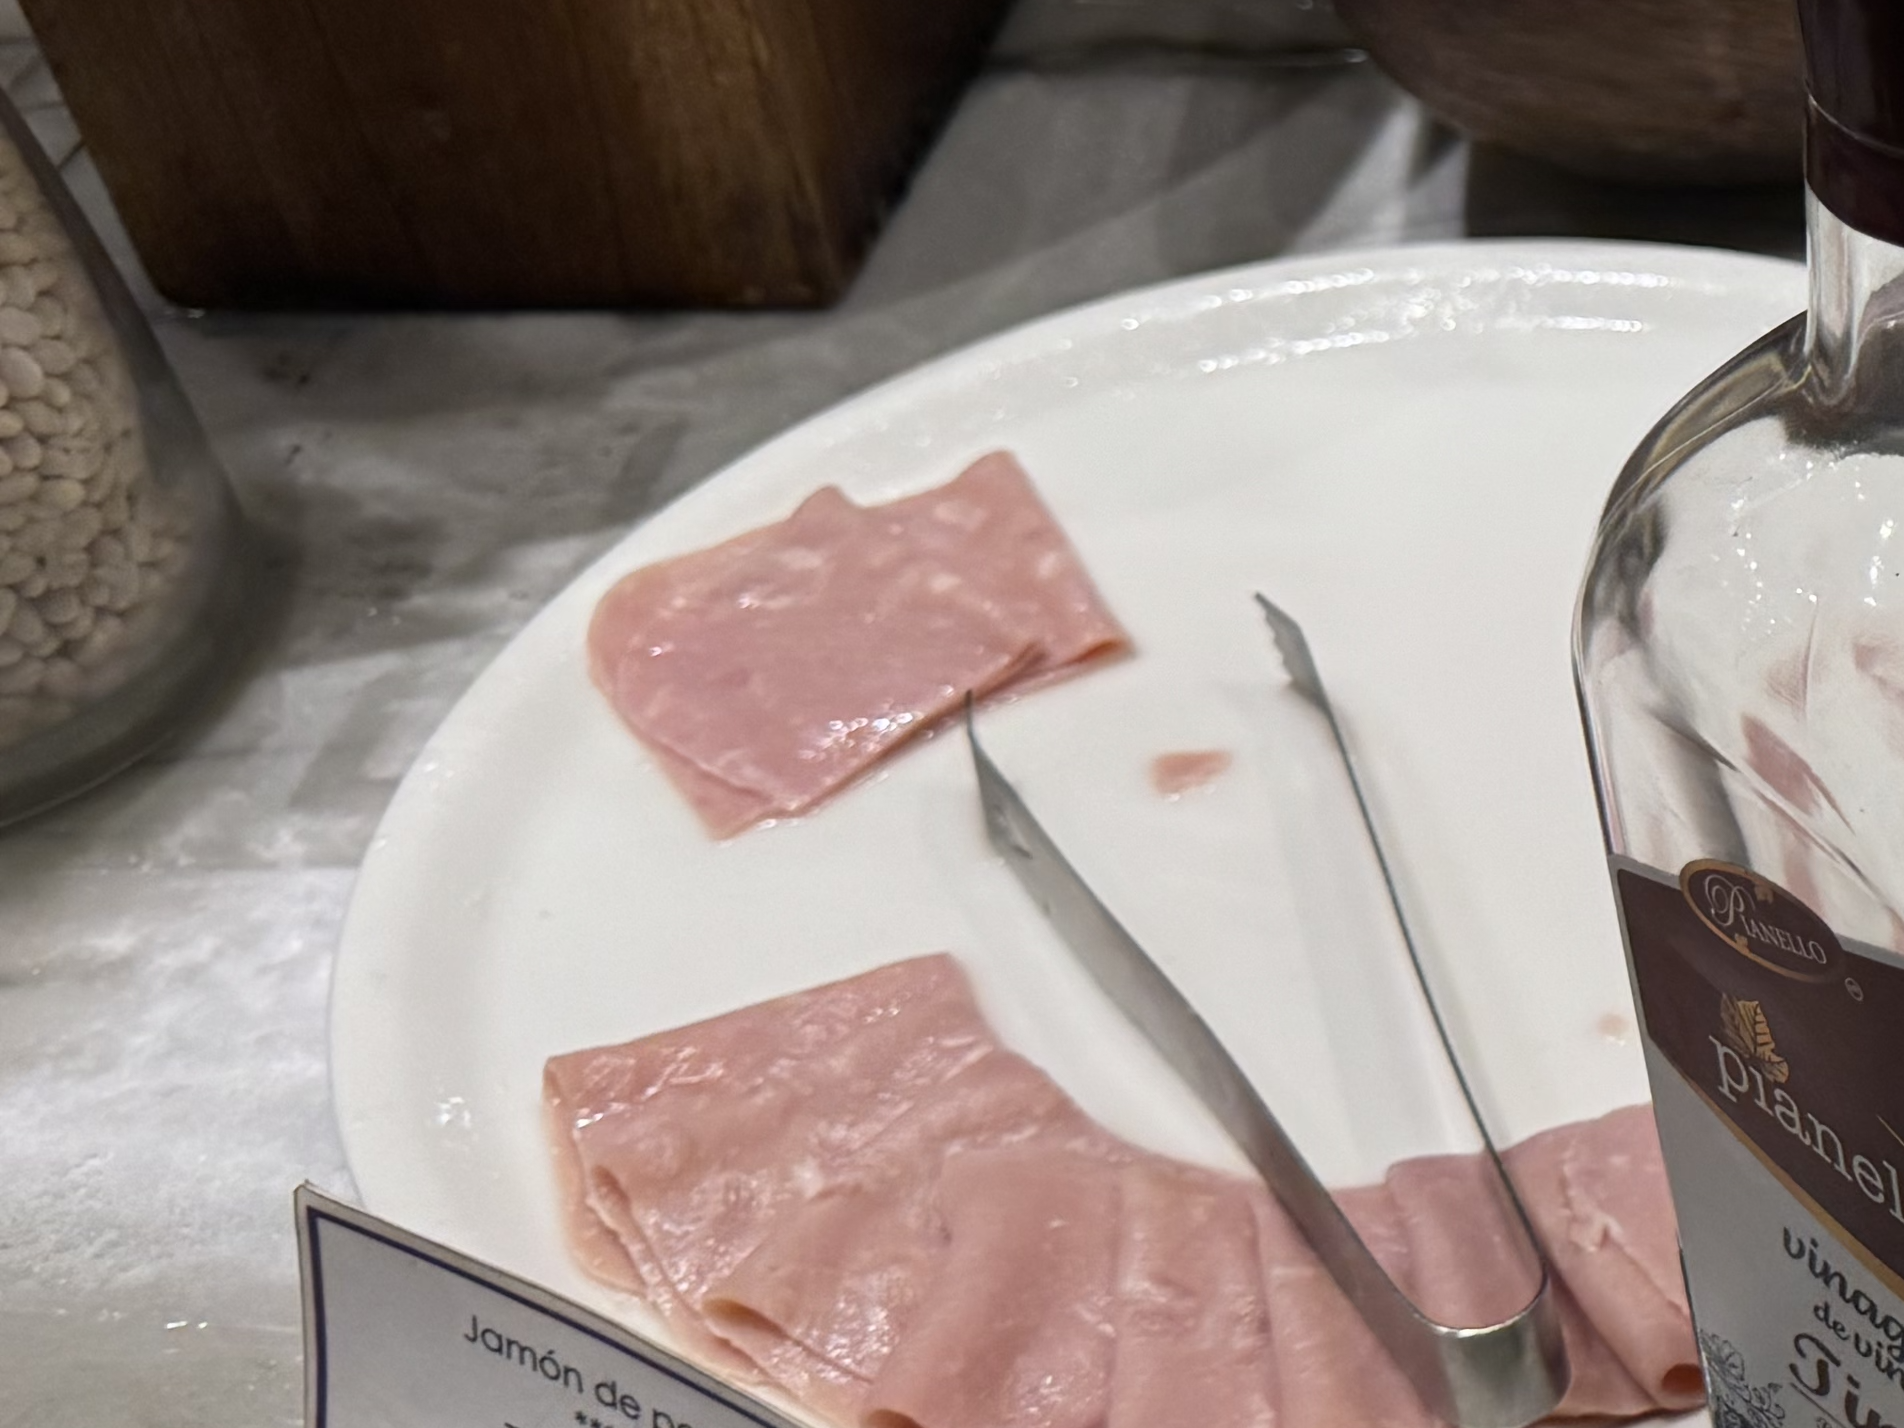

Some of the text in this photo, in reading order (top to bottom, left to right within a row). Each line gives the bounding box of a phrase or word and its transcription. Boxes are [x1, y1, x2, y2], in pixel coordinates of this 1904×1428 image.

[1704, 873, 1828, 965] PIANELLO
[1814, 1301, 1850, 1341] de
[464, 1315, 585, 1394] Jamón
[594, 1380, 642, 1420] de
